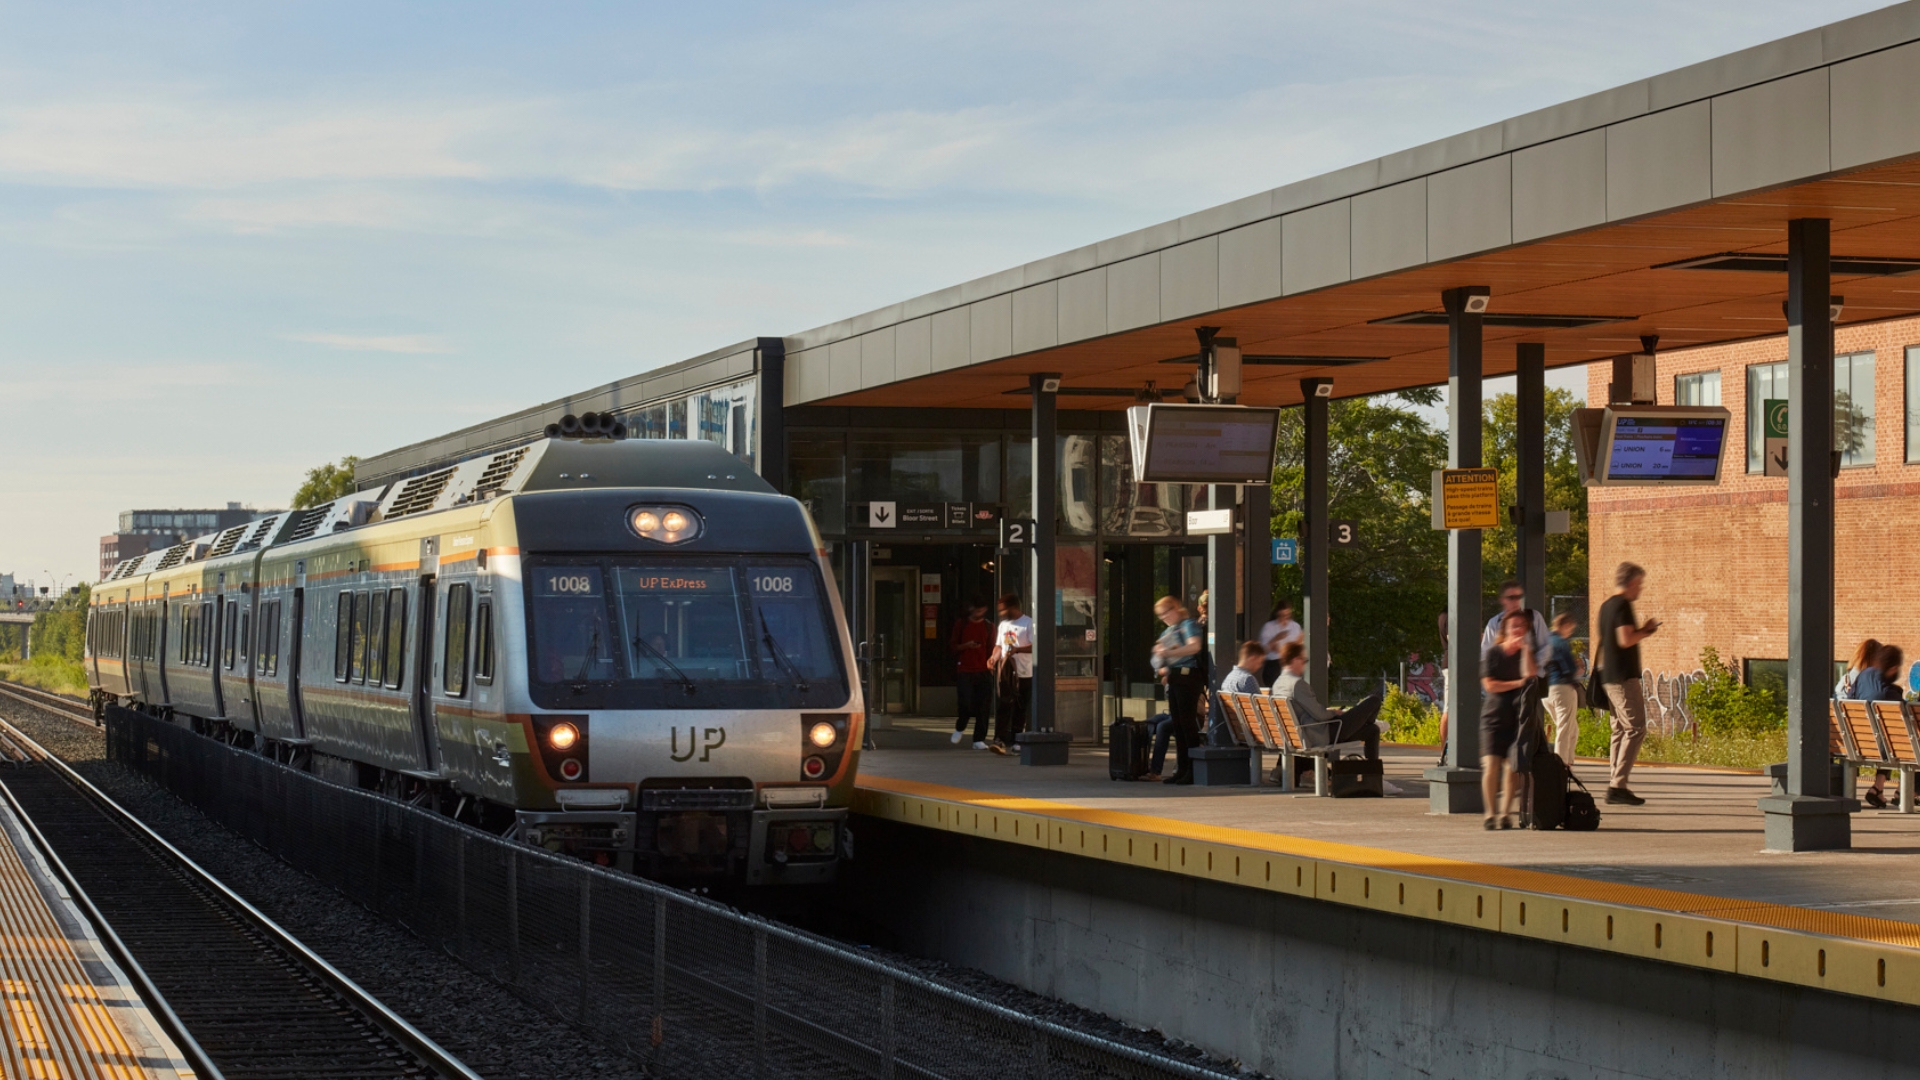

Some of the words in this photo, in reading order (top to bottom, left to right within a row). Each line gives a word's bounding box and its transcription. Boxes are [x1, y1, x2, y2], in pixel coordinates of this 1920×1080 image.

[1445, 474, 1494, 483] ATTENTION
[902, 514, 919, 522] Bloor
[1009, 524, 1024, 543] 2
[1337, 524, 1352, 544] 3
[549, 576, 590, 592] 1008
[639, 577, 659, 589] UP
[753, 576, 793, 592] 1008
[669, 726, 726, 763] UP
